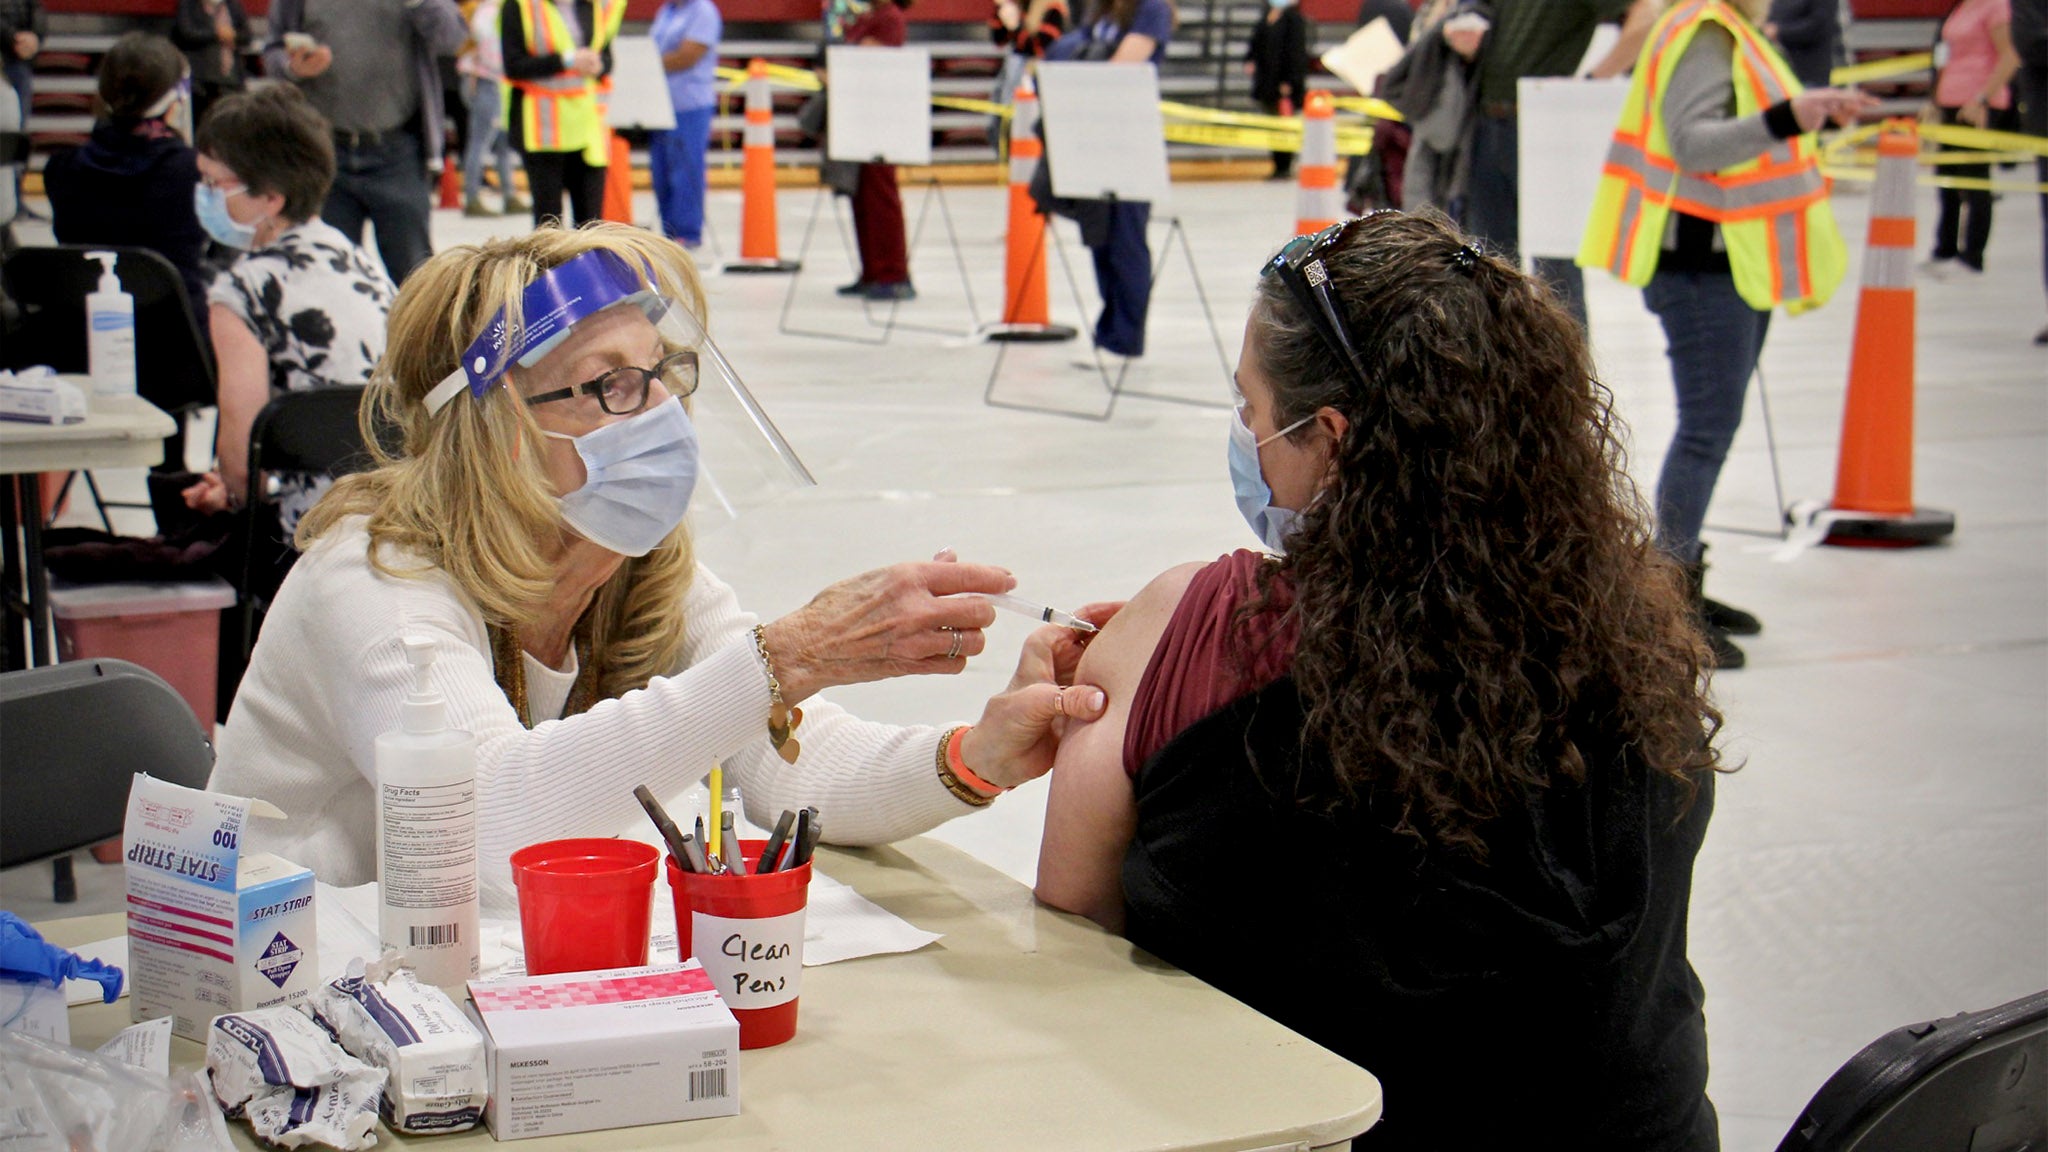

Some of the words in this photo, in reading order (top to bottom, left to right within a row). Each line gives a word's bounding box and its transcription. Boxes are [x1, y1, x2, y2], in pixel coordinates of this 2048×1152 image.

[212, 829, 237, 850] 100
[127, 842, 175, 871] STRIP
[176, 855, 219, 882] STAT
[252, 904, 281, 920] STAT
[282, 895, 312, 913] STRIP
[271, 939, 288, 950] STAT
[722, 933, 790, 962] Clean
[733, 972, 785, 994] Pens
[288, 989, 308, 1001] 15200
